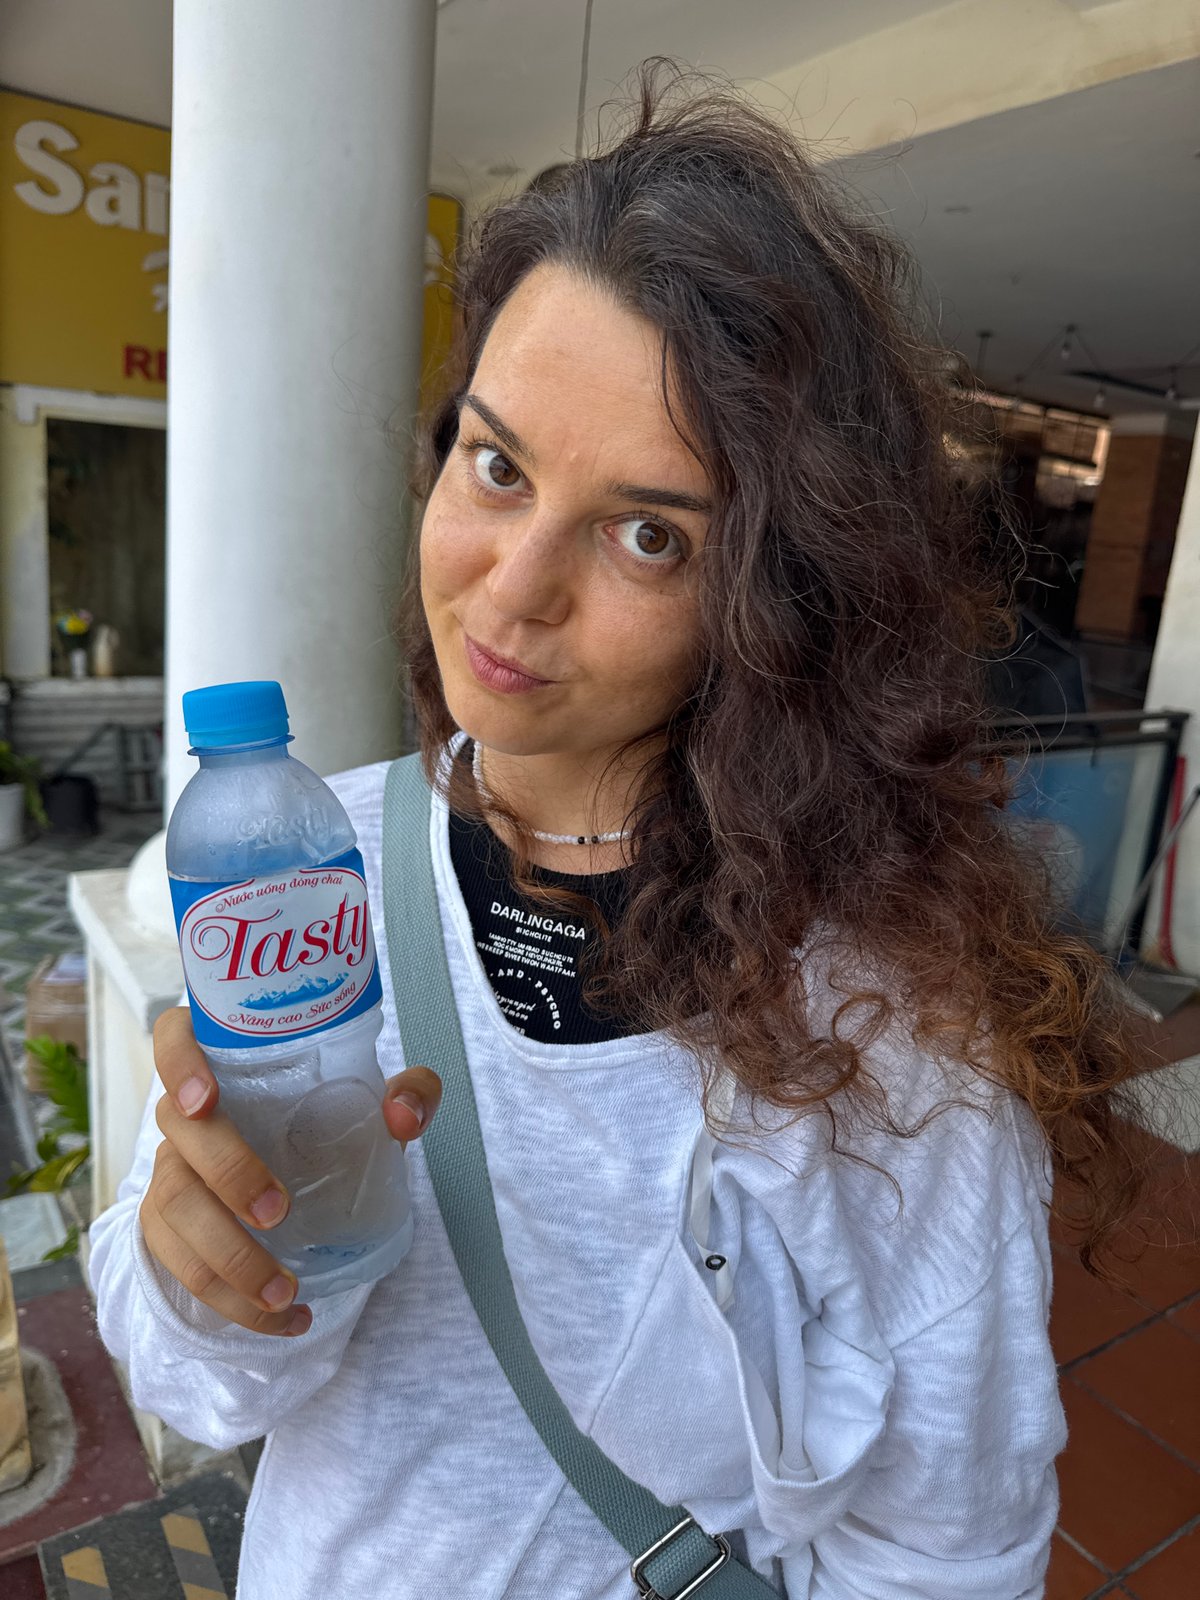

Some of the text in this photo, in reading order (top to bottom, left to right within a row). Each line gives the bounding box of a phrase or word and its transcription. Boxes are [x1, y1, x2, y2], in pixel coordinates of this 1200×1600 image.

[321, 874, 343, 885] chai
[490, 901, 586, 940] DARLINGAGA
[190, 892, 368, 981] Tasty
[497, 968, 525, 979] AND
[227, 1013, 275, 1029] Nâng
[277, 1013, 303, 1025] cao
